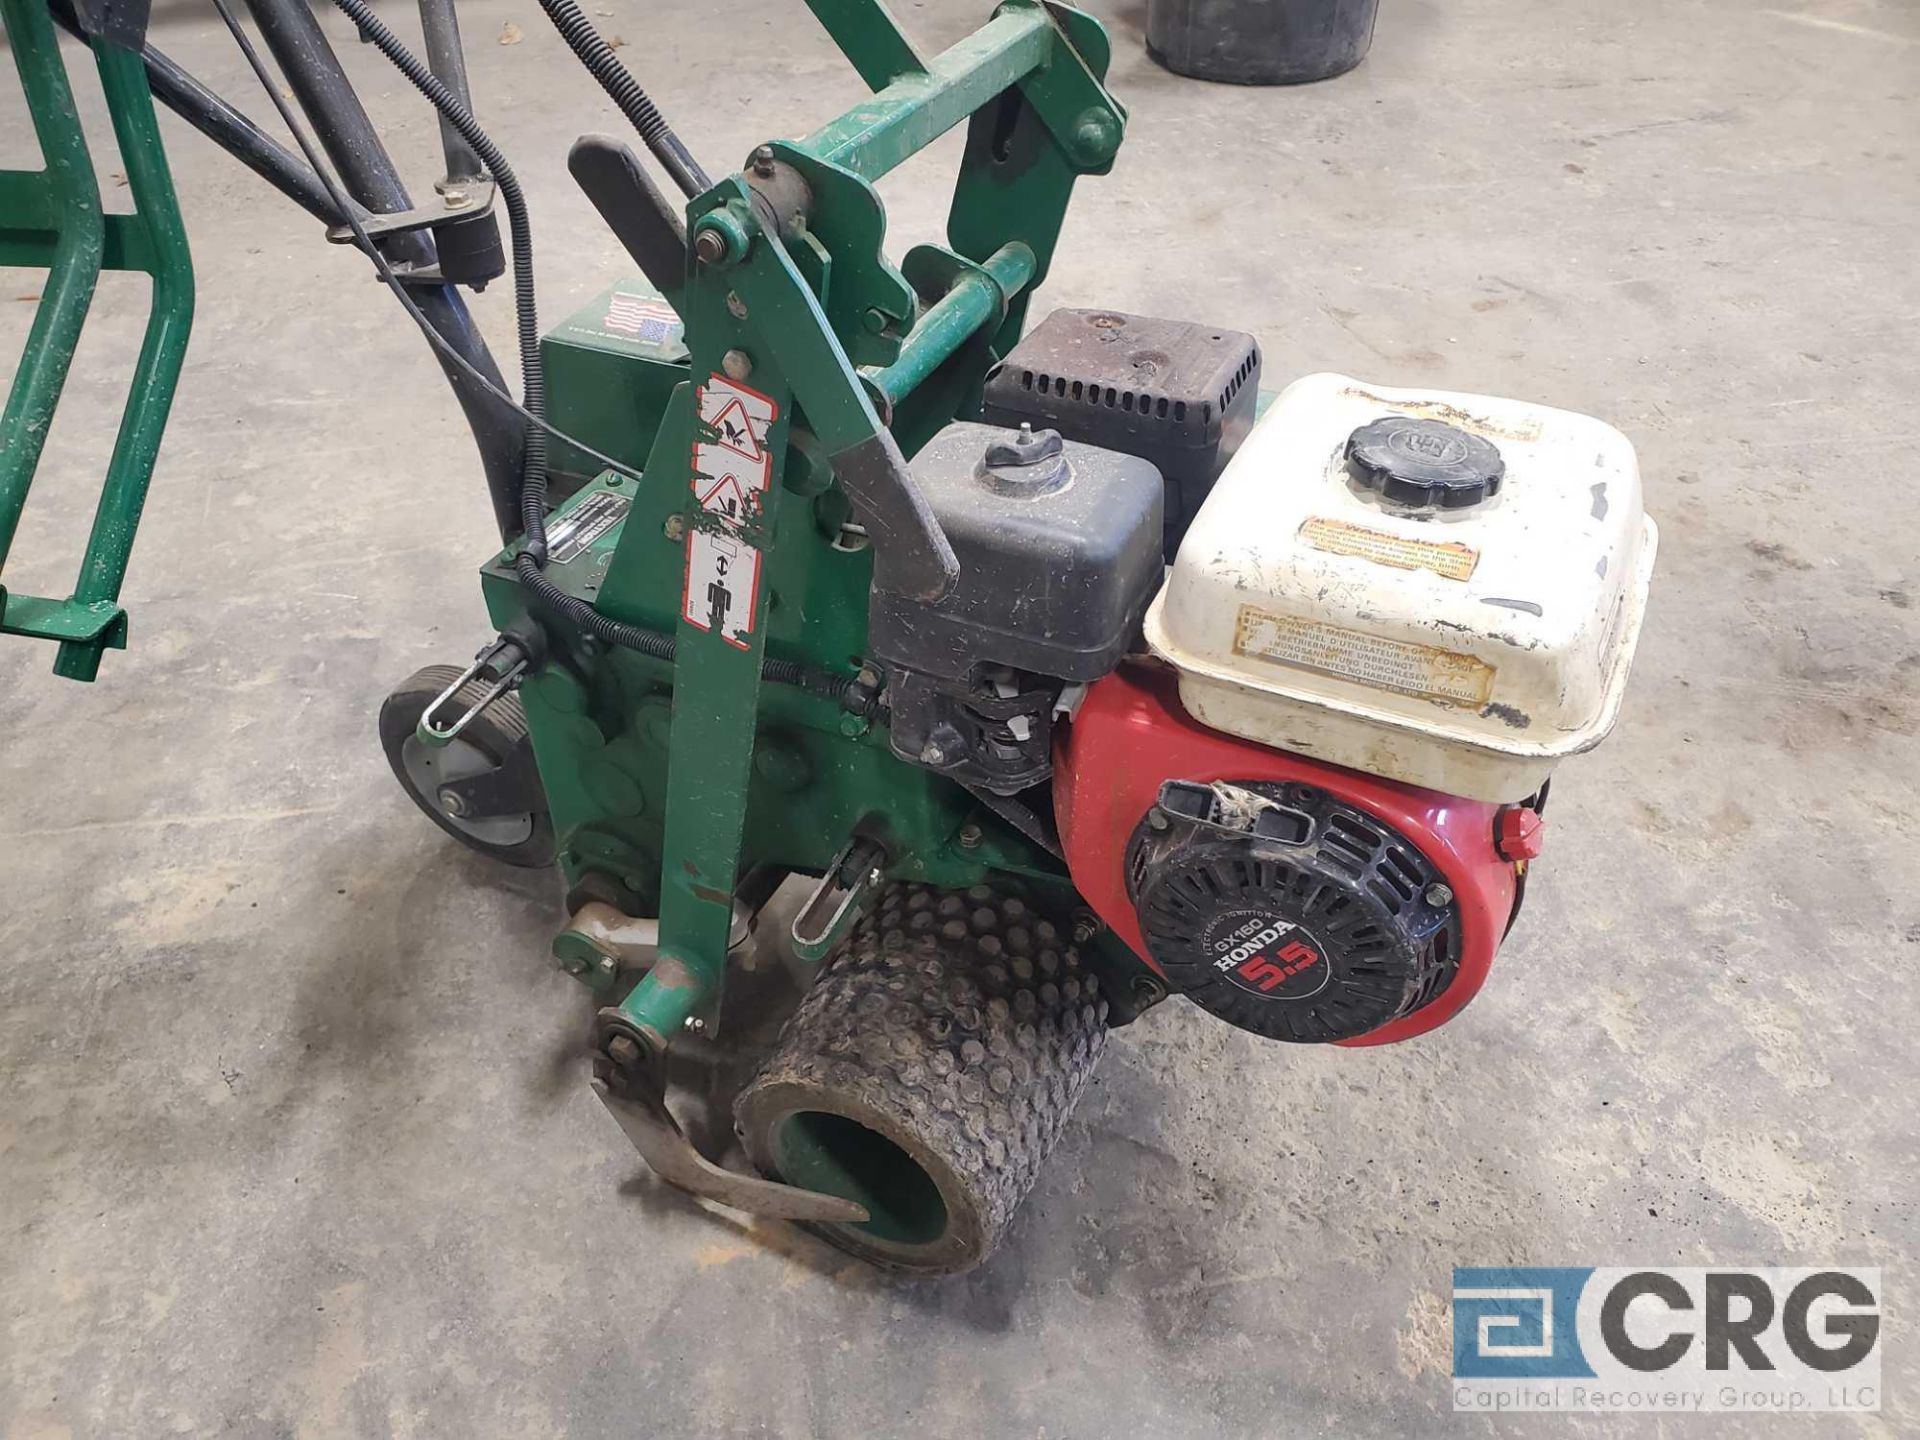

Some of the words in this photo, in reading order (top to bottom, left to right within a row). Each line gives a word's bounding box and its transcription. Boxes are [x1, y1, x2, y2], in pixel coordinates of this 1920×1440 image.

[1325, 627, 1367, 643] MANUAL
[1357, 651, 1414, 671] UNBEDINGT
[1363, 661, 1429, 682] DURCHLESEN
[1317, 658, 1346, 672] ANTES
[1348, 666, 1361, 676] NO
[1363, 669, 1395, 683] HABER
[1437, 685, 1477, 700] MANUAL
[1212, 919, 1297, 972] HONDA
[1214, 918, 1264, 953] GX160
[1236, 940, 1319, 992] 5.5
